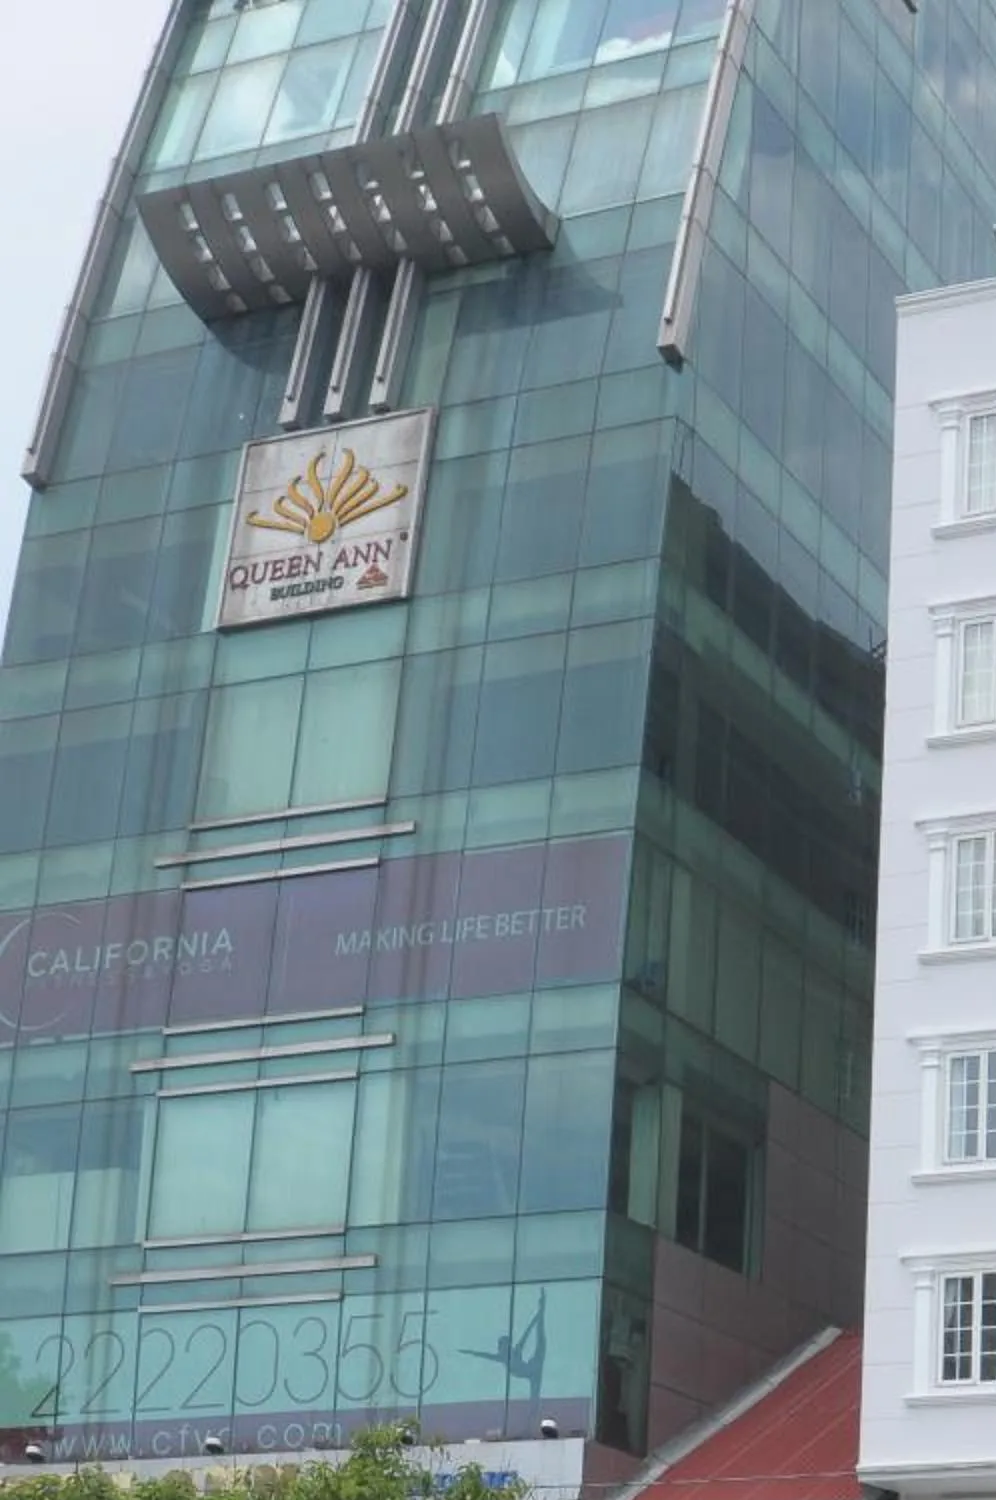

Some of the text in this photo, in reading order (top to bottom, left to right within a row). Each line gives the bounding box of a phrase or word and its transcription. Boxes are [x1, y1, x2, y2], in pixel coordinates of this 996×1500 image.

[229, 539, 394, 590] QUEEN ANN
[270, 577, 344, 601] BUILDING
[28, 928, 233, 977] CALIFORNIA
[335, 905, 586, 955] MAKING LIFE BETTER
[30, 1309, 439, 1418] 22220355
